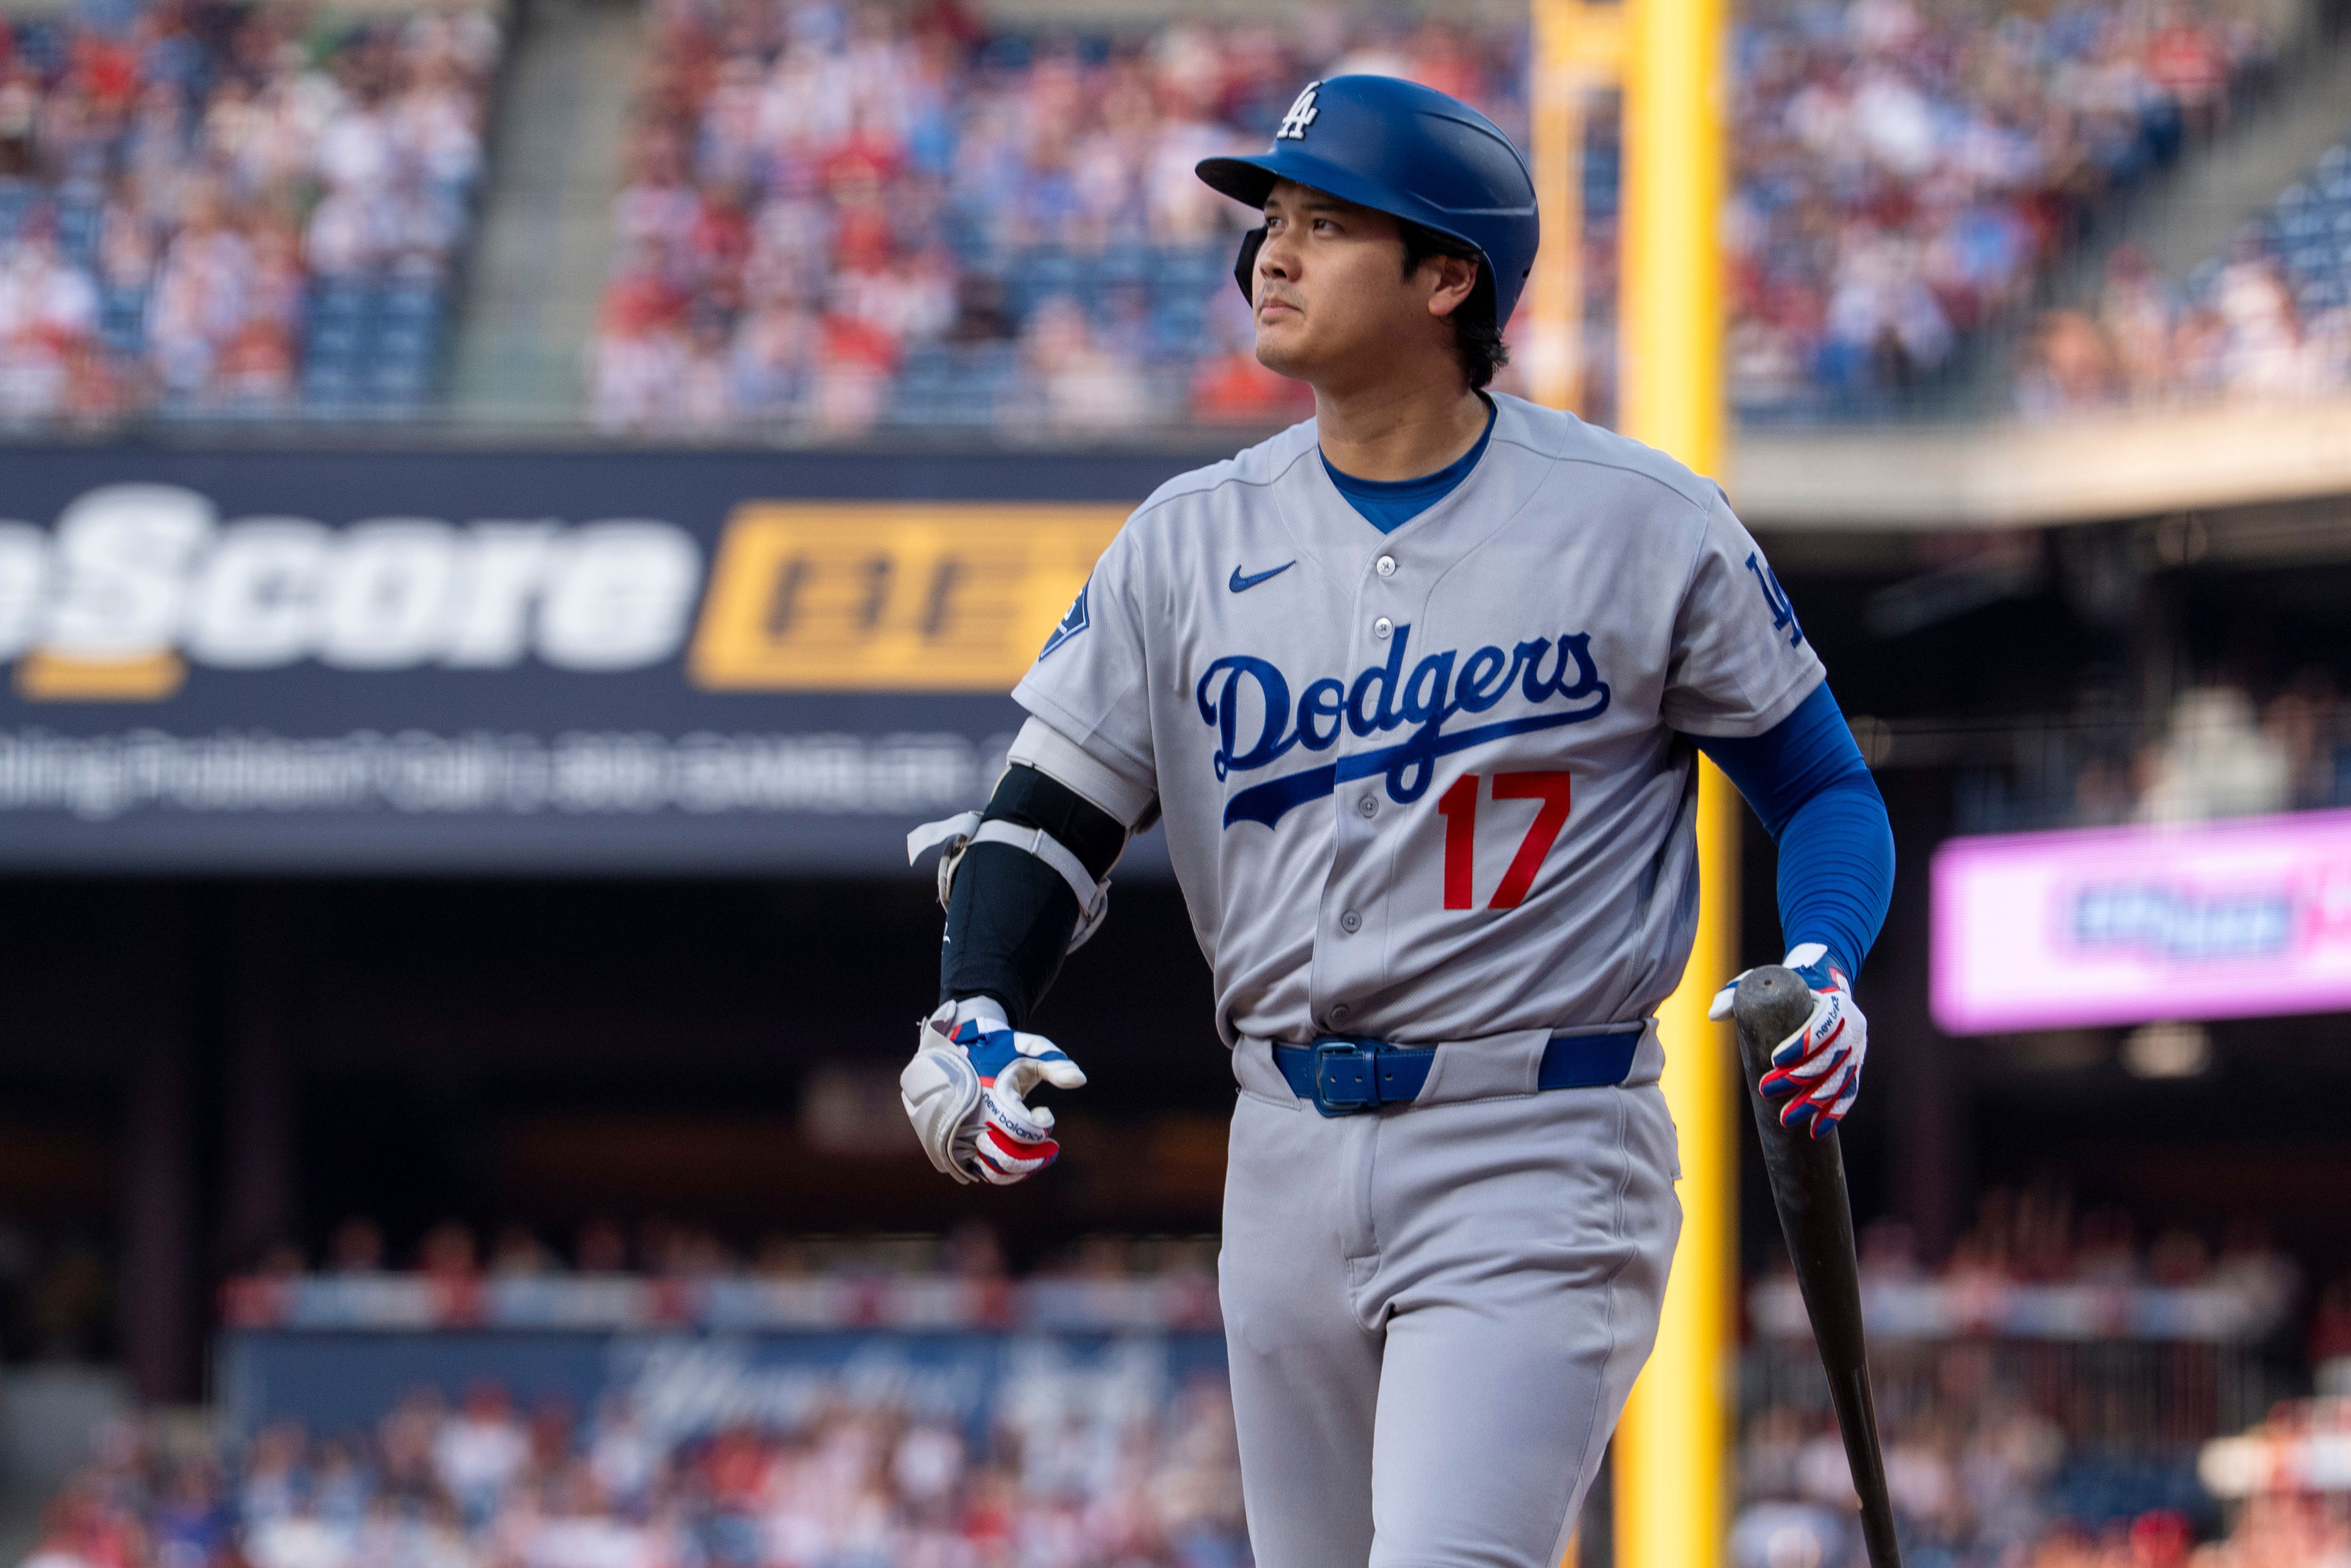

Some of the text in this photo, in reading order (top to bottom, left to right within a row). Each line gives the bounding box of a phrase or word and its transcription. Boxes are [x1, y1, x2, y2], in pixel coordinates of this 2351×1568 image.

[1277, 81, 1320, 140] LA
[765, 551, 1090, 647] BE
[1196, 623, 1611, 831] Dodgers
[1438, 771, 1570, 910] 17
[983, 1092, 1000, 1116] new
